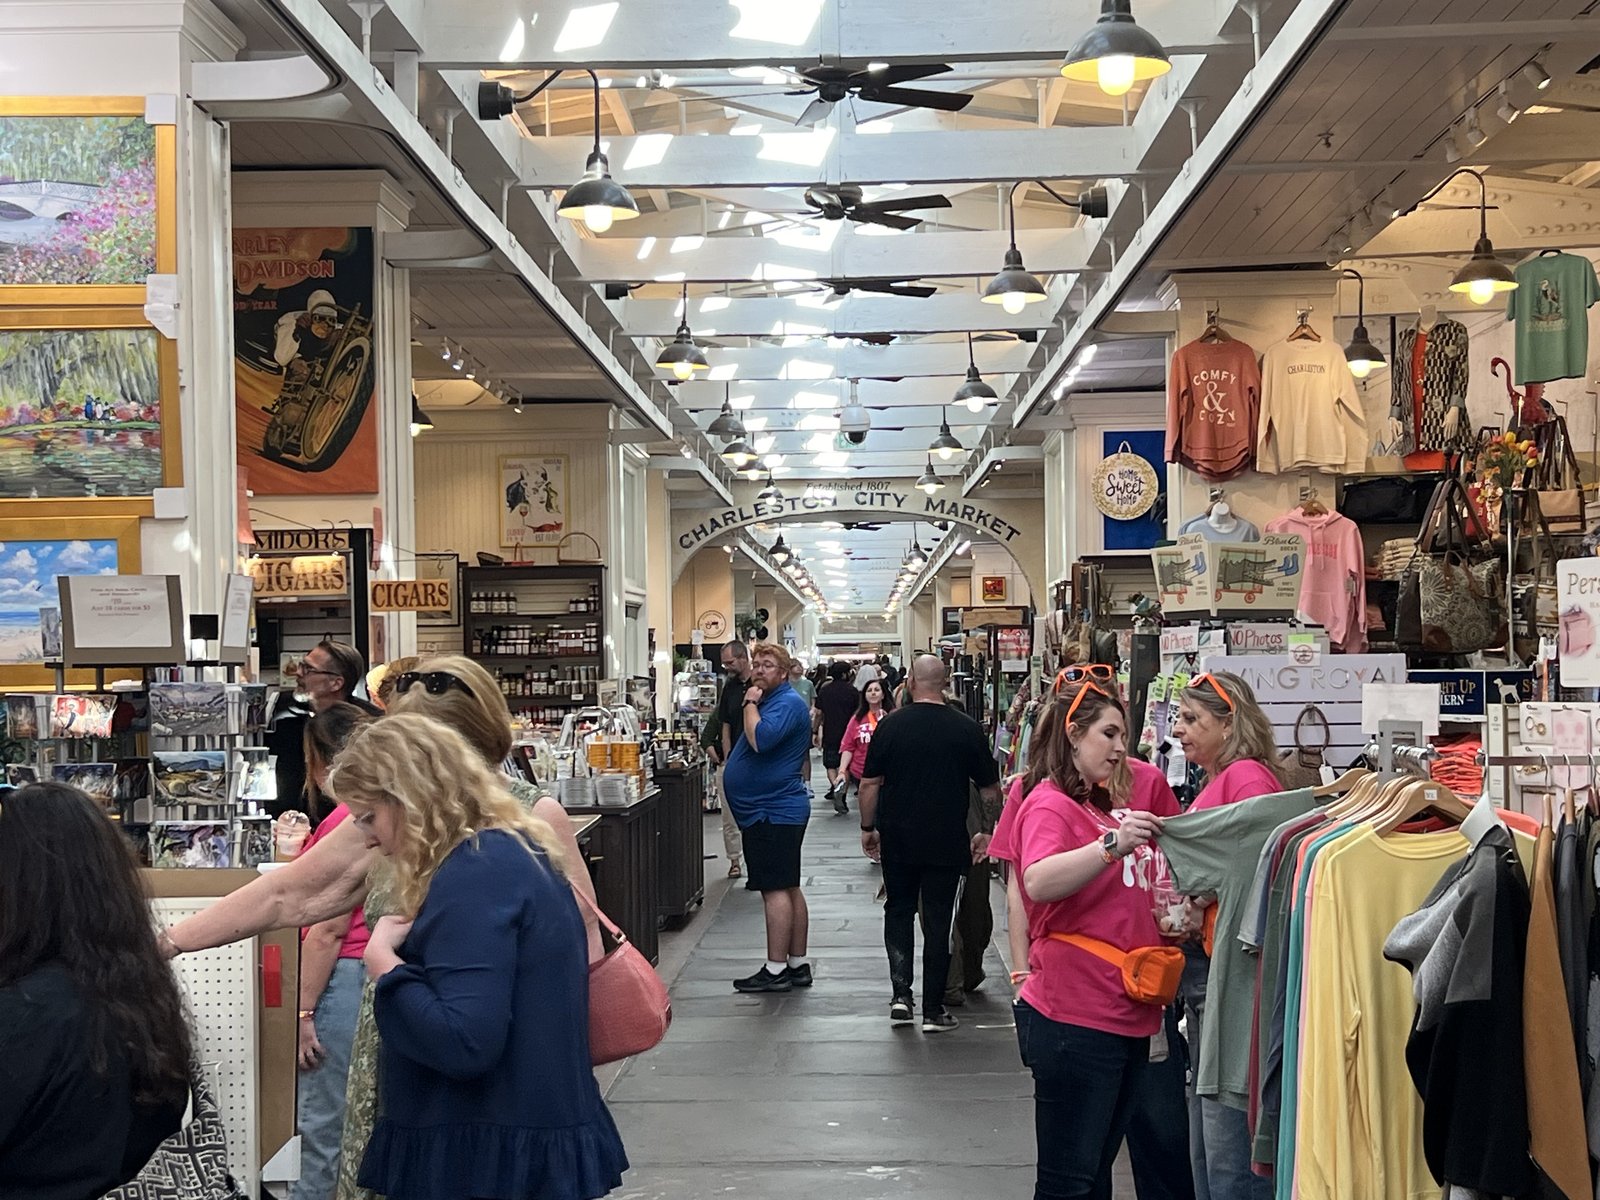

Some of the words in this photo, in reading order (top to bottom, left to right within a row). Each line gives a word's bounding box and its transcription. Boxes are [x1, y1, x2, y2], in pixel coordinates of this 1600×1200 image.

[232, 235, 294, 256] ARLEY
[237, 259, 335, 285] DAVIDSON
[1193, 368, 1237, 386] COMFY
[1287, 363, 1326, 375] CHARLESTON
[1203, 381, 1228, 413] &
[1199, 410, 1236, 425] COZY
[806, 481, 862, 491] Established
[866, 480, 891, 491] 1807
[1106, 473, 1145, 497] Sweet
[854, 491, 908, 508] CITY
[924, 496, 1021, 542] MARKET
[254, 530, 346, 549] MIDORS
[1262, 536, 1287, 545] Blue
[253, 560, 345, 592] CIGARS
[371, 582, 450, 607] CIGARS
[1228, 629, 1243, 647] NO
[1244, 629, 1283, 648] Photos
